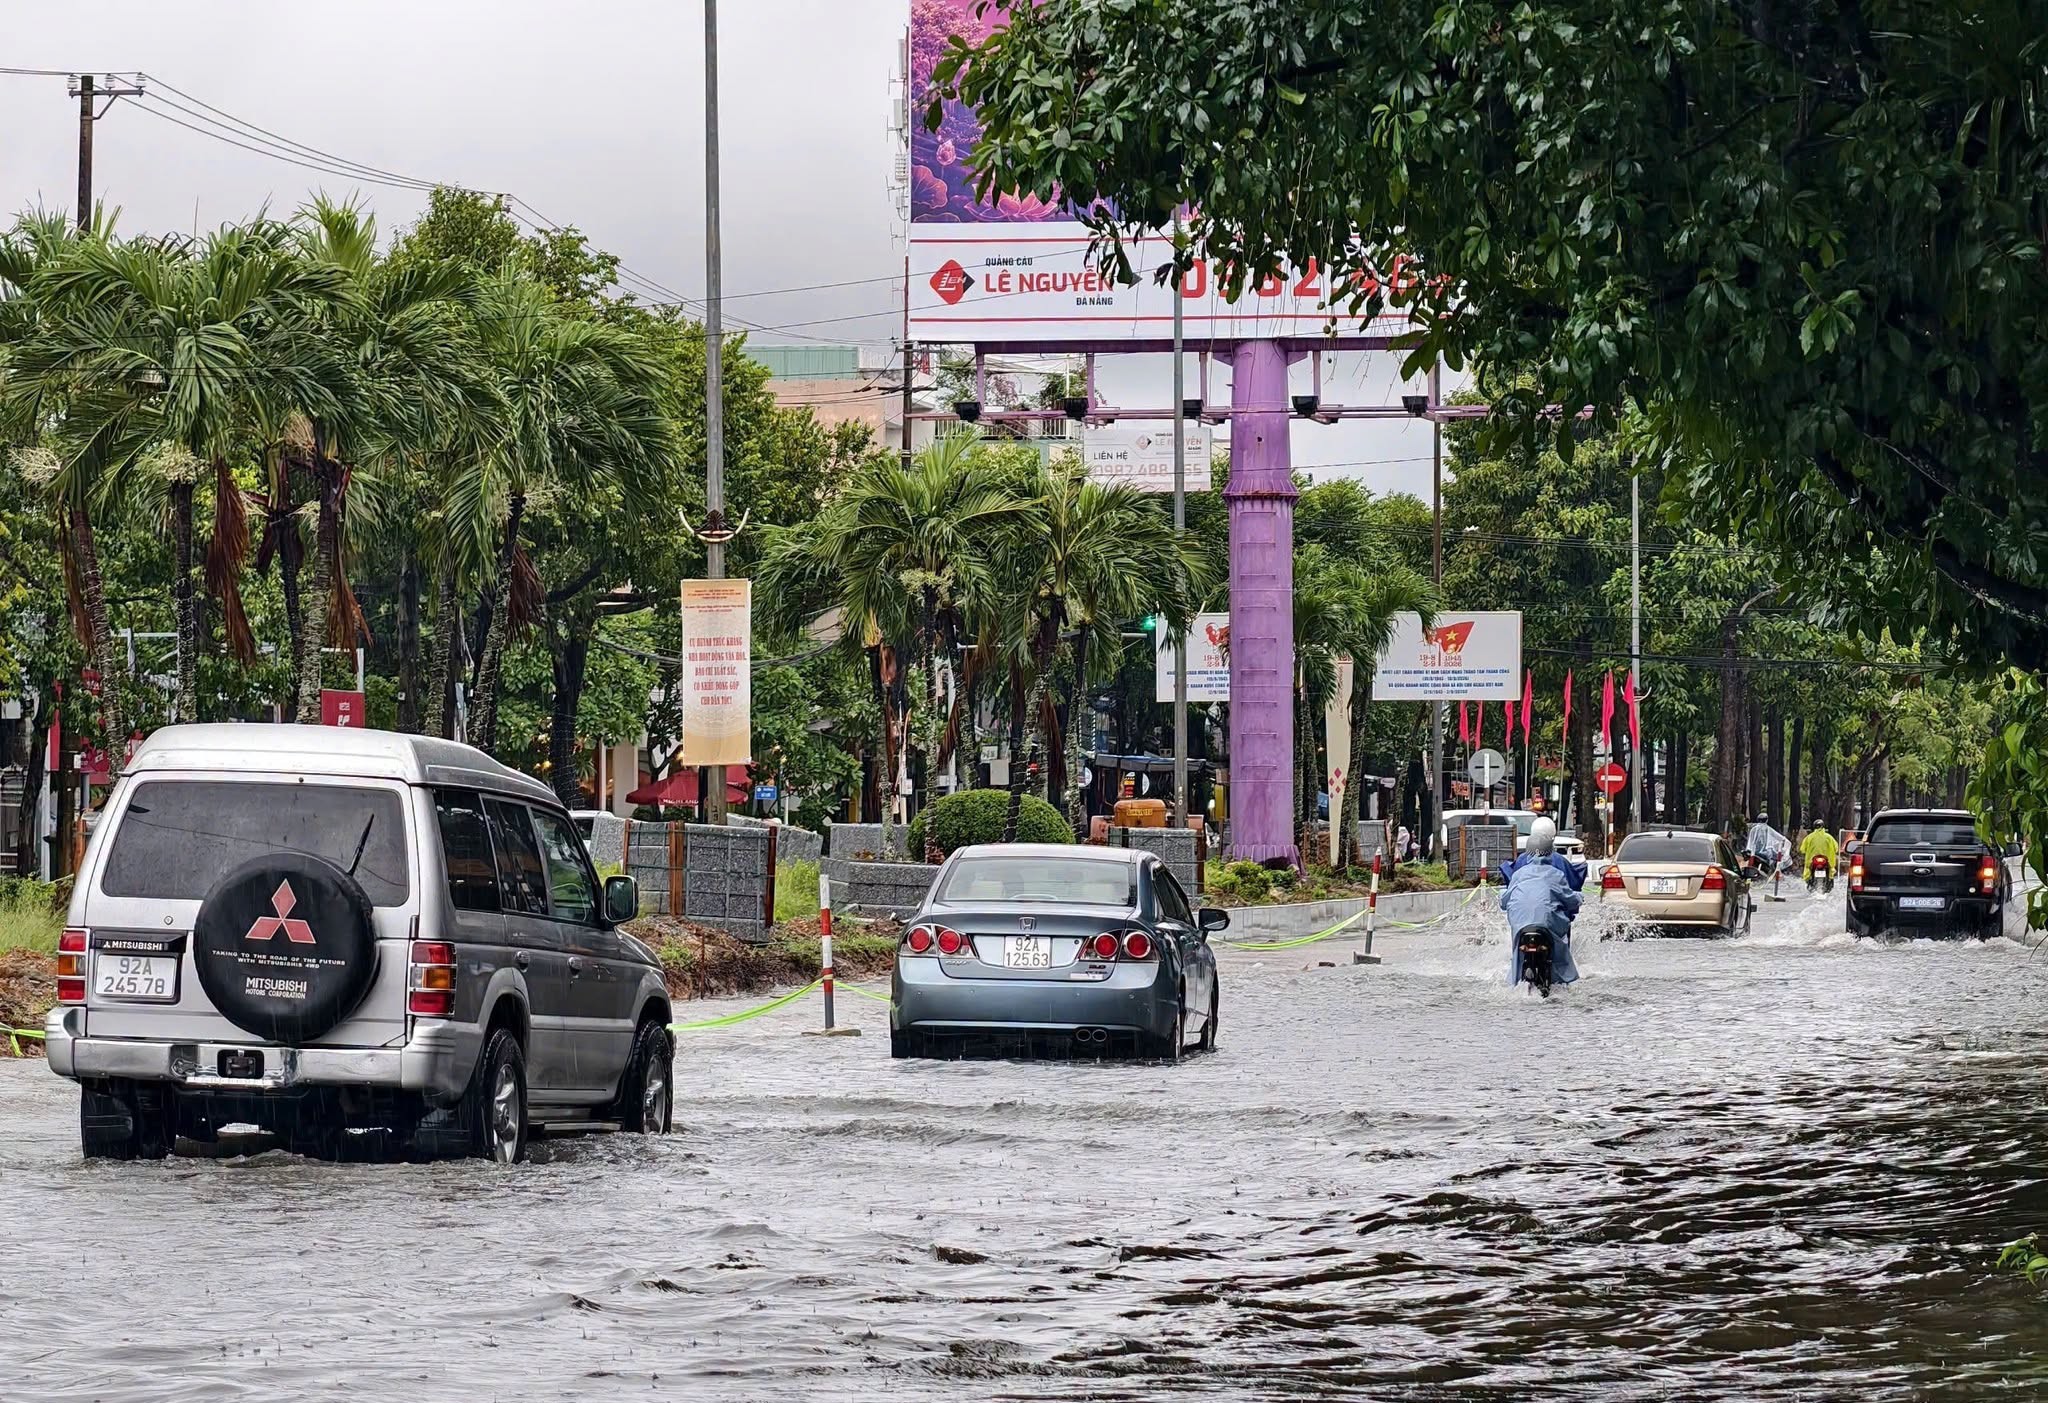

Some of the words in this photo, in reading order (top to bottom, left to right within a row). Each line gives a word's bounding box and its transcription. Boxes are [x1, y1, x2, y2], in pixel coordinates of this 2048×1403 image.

[986, 254, 1014, 266] QUẢNG
[985, 269, 1012, 292] LÊ
[1019, 264, 1114, 292] NGUYỄN
[1094, 450, 1113, 460] LIÊN
[1116, 450, 1128, 461] HỆ
[112, 940, 162, 951] MITSUBISHI
[1016, 936, 1040, 952] 92A
[119, 957, 152, 975] 92A
[1006, 952, 1048, 968] 125.63
[104, 976, 165, 994] 245.78
[246, 977, 307, 993] MITSUBISHI
[245, 988, 266, 996] MOTORS
[268, 990, 306, 1000] CORPORATION
